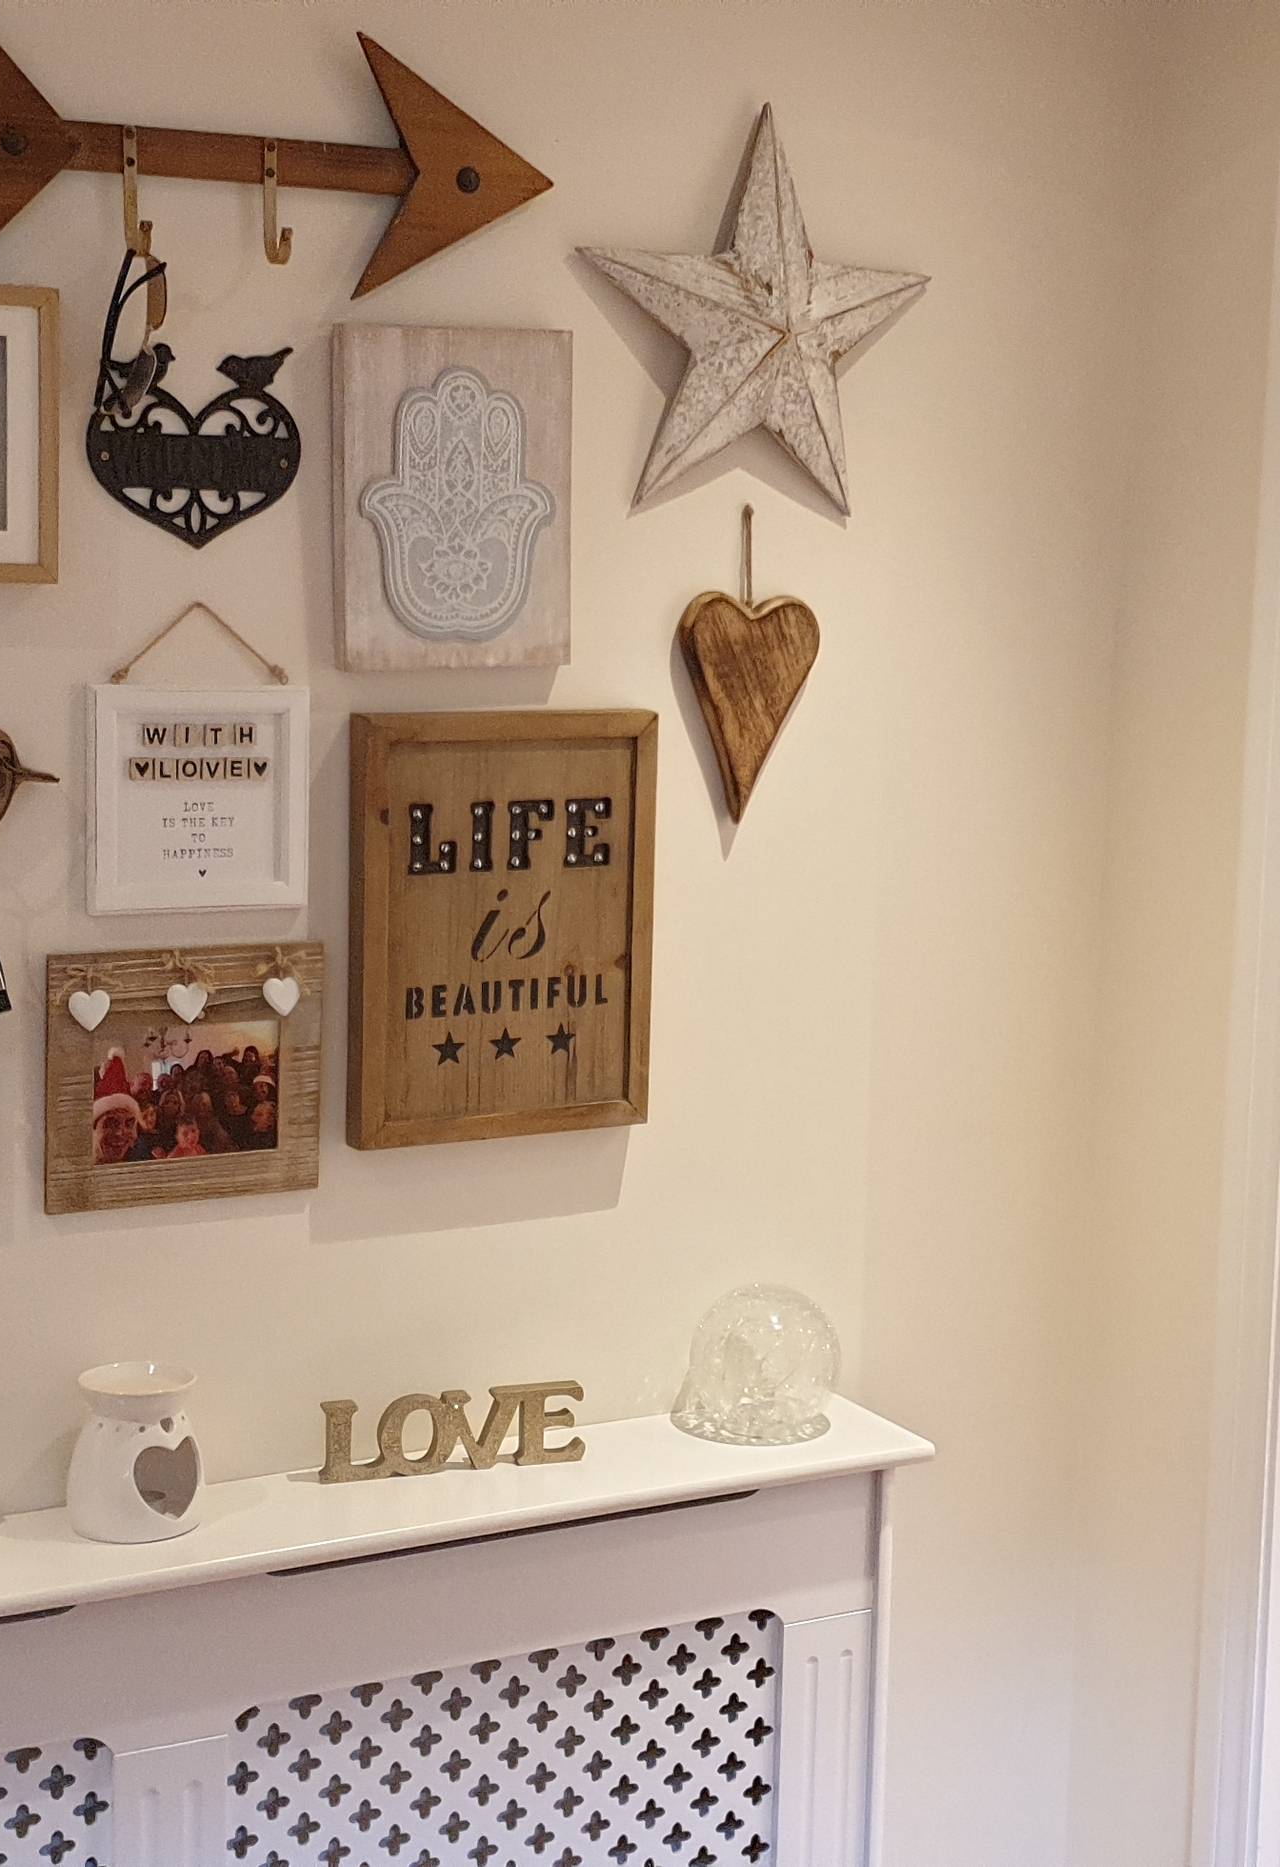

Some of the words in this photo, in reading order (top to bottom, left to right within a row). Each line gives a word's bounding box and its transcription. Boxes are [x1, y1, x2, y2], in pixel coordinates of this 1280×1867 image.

[146, 726, 254, 745] WITH
[159, 760, 244, 779] LOVE
[183, 801, 215, 813] LOVE
[162, 817, 176, 829] IS
[181, 817, 206, 828] THE
[211, 816, 235, 828] KEY
[191, 833, 206, 843] TO
[408, 796, 612, 876] LIFE
[162, 847, 234, 860] HAPPINESS
[470, 888, 551, 963] is
[404, 973, 609, 1020] BEAUTIFUL
[318, 1379, 586, 1485] LOVE
